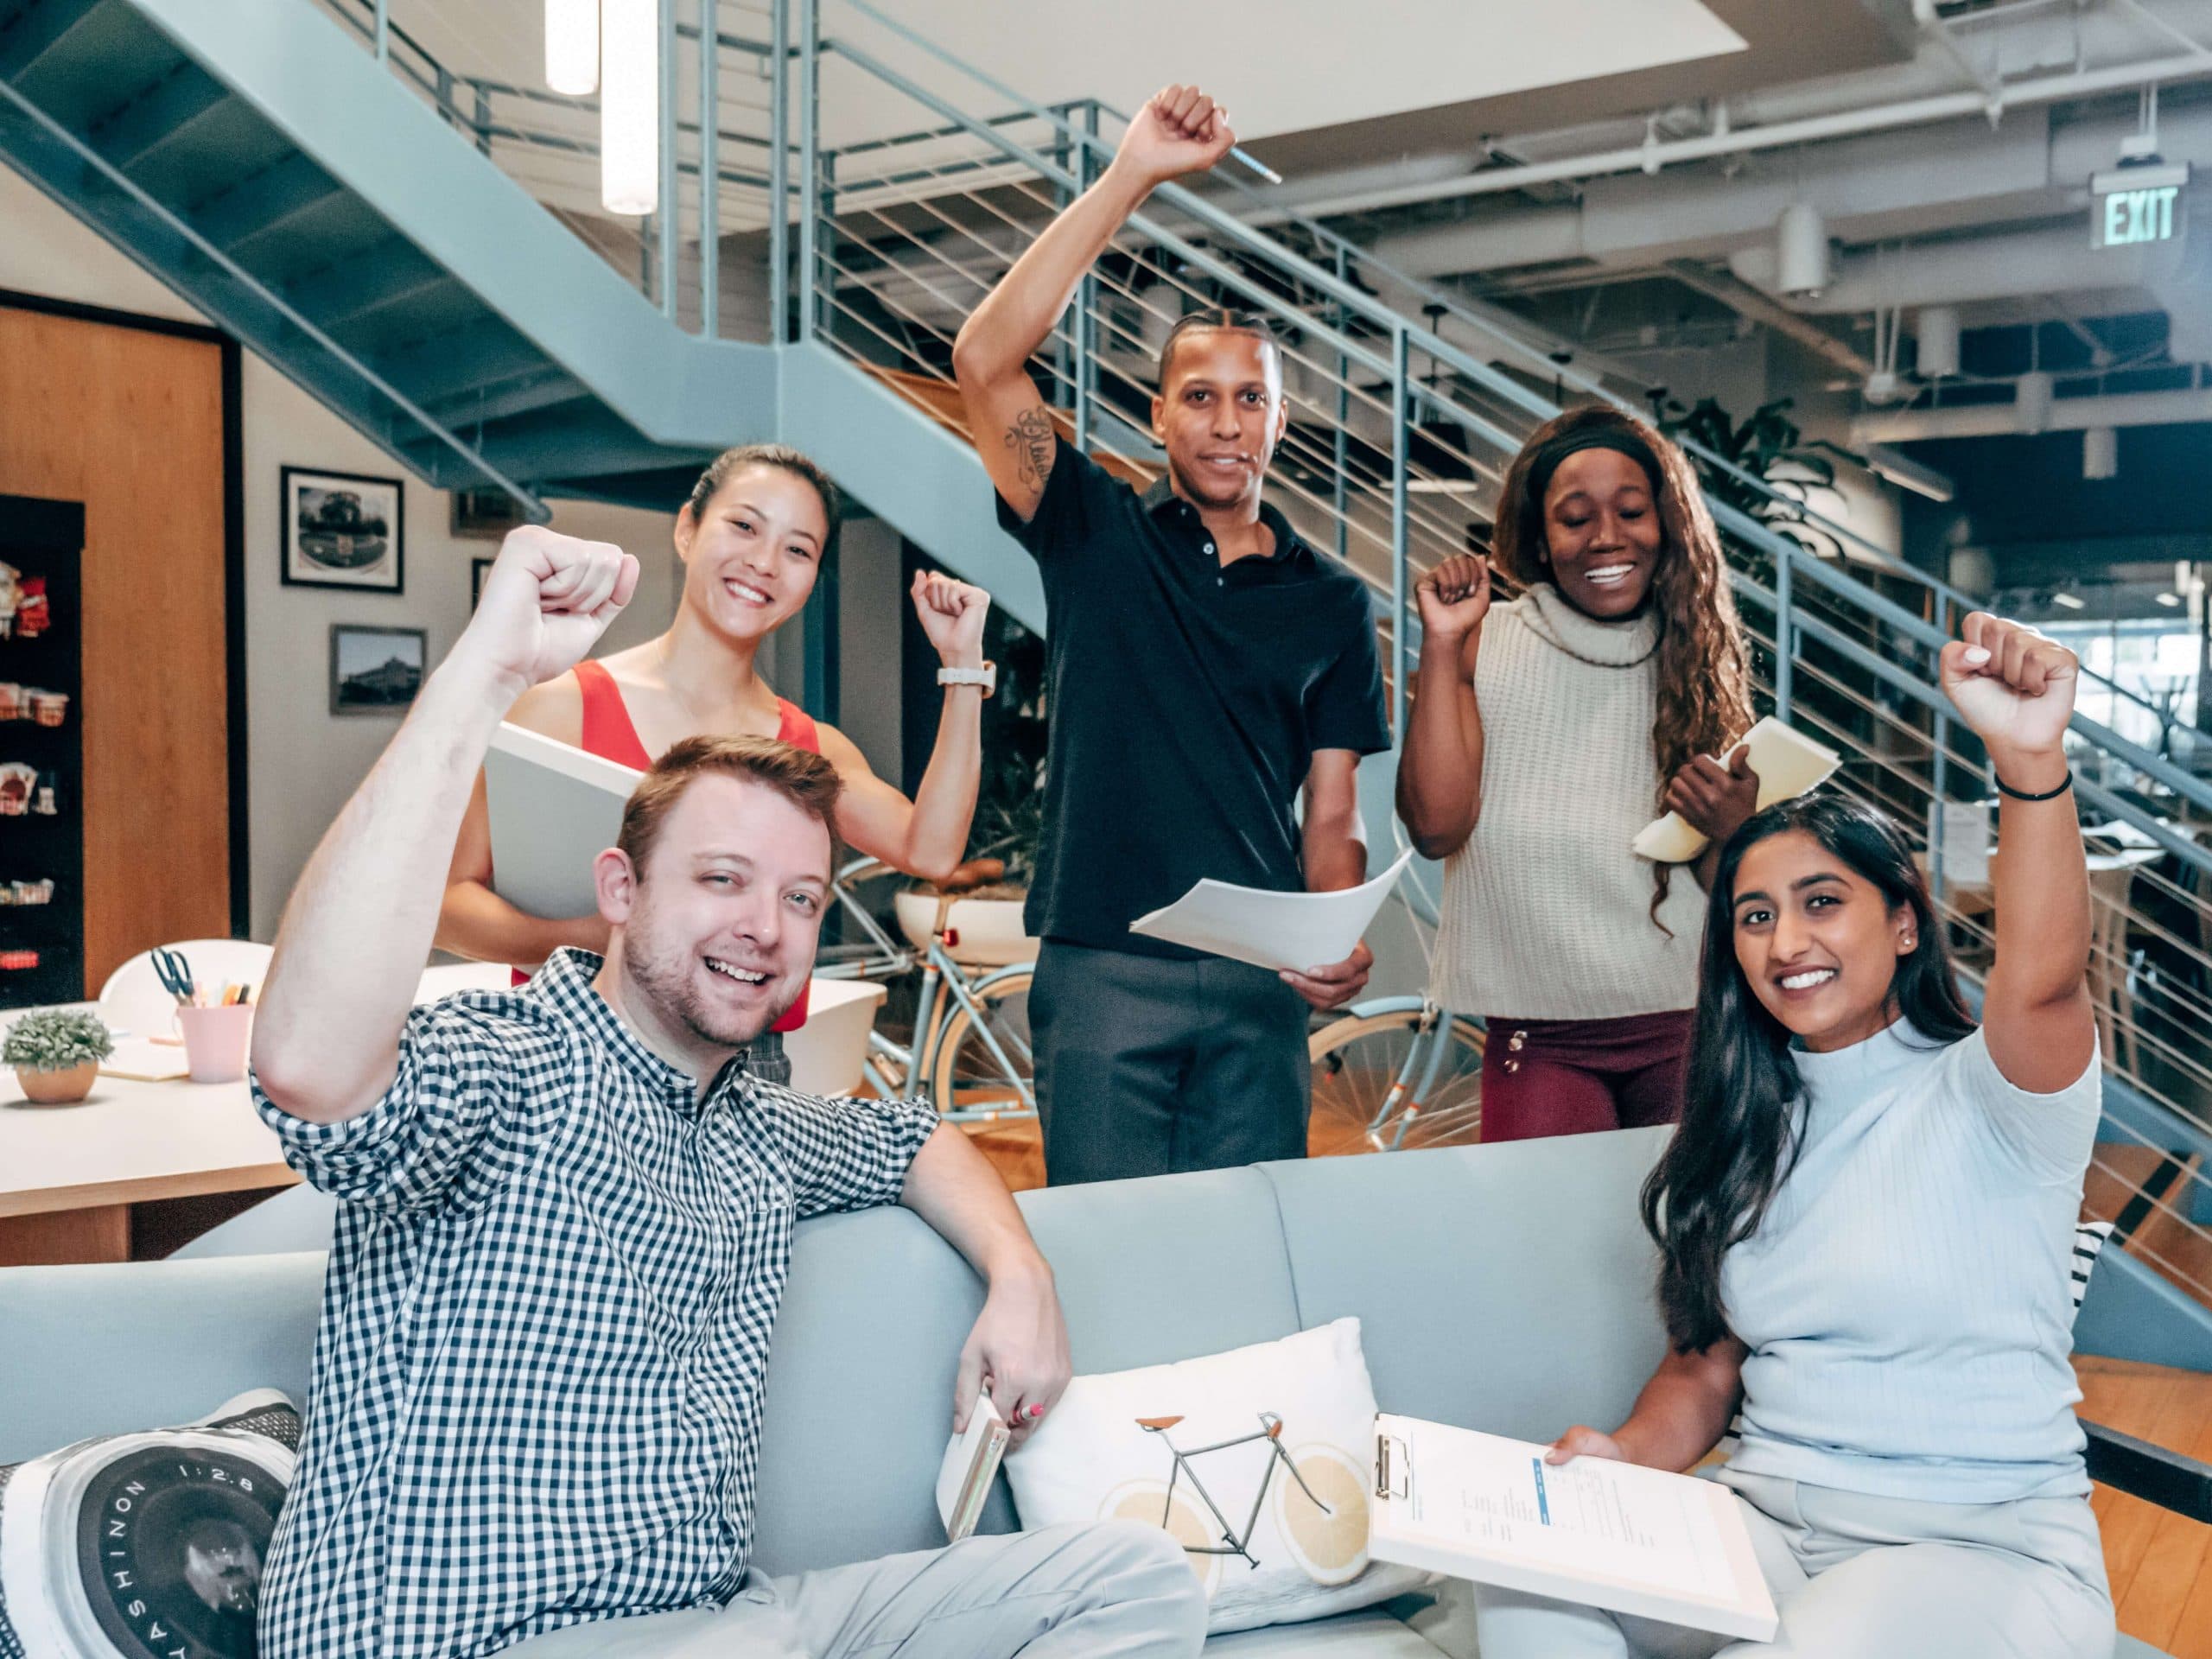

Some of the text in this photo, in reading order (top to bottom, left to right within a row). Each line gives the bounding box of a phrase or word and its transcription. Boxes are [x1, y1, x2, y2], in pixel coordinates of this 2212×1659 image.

[2104, 187, 2178, 245] EXIT
[109, 1465, 253, 1659] YASHINON 1:2.8
